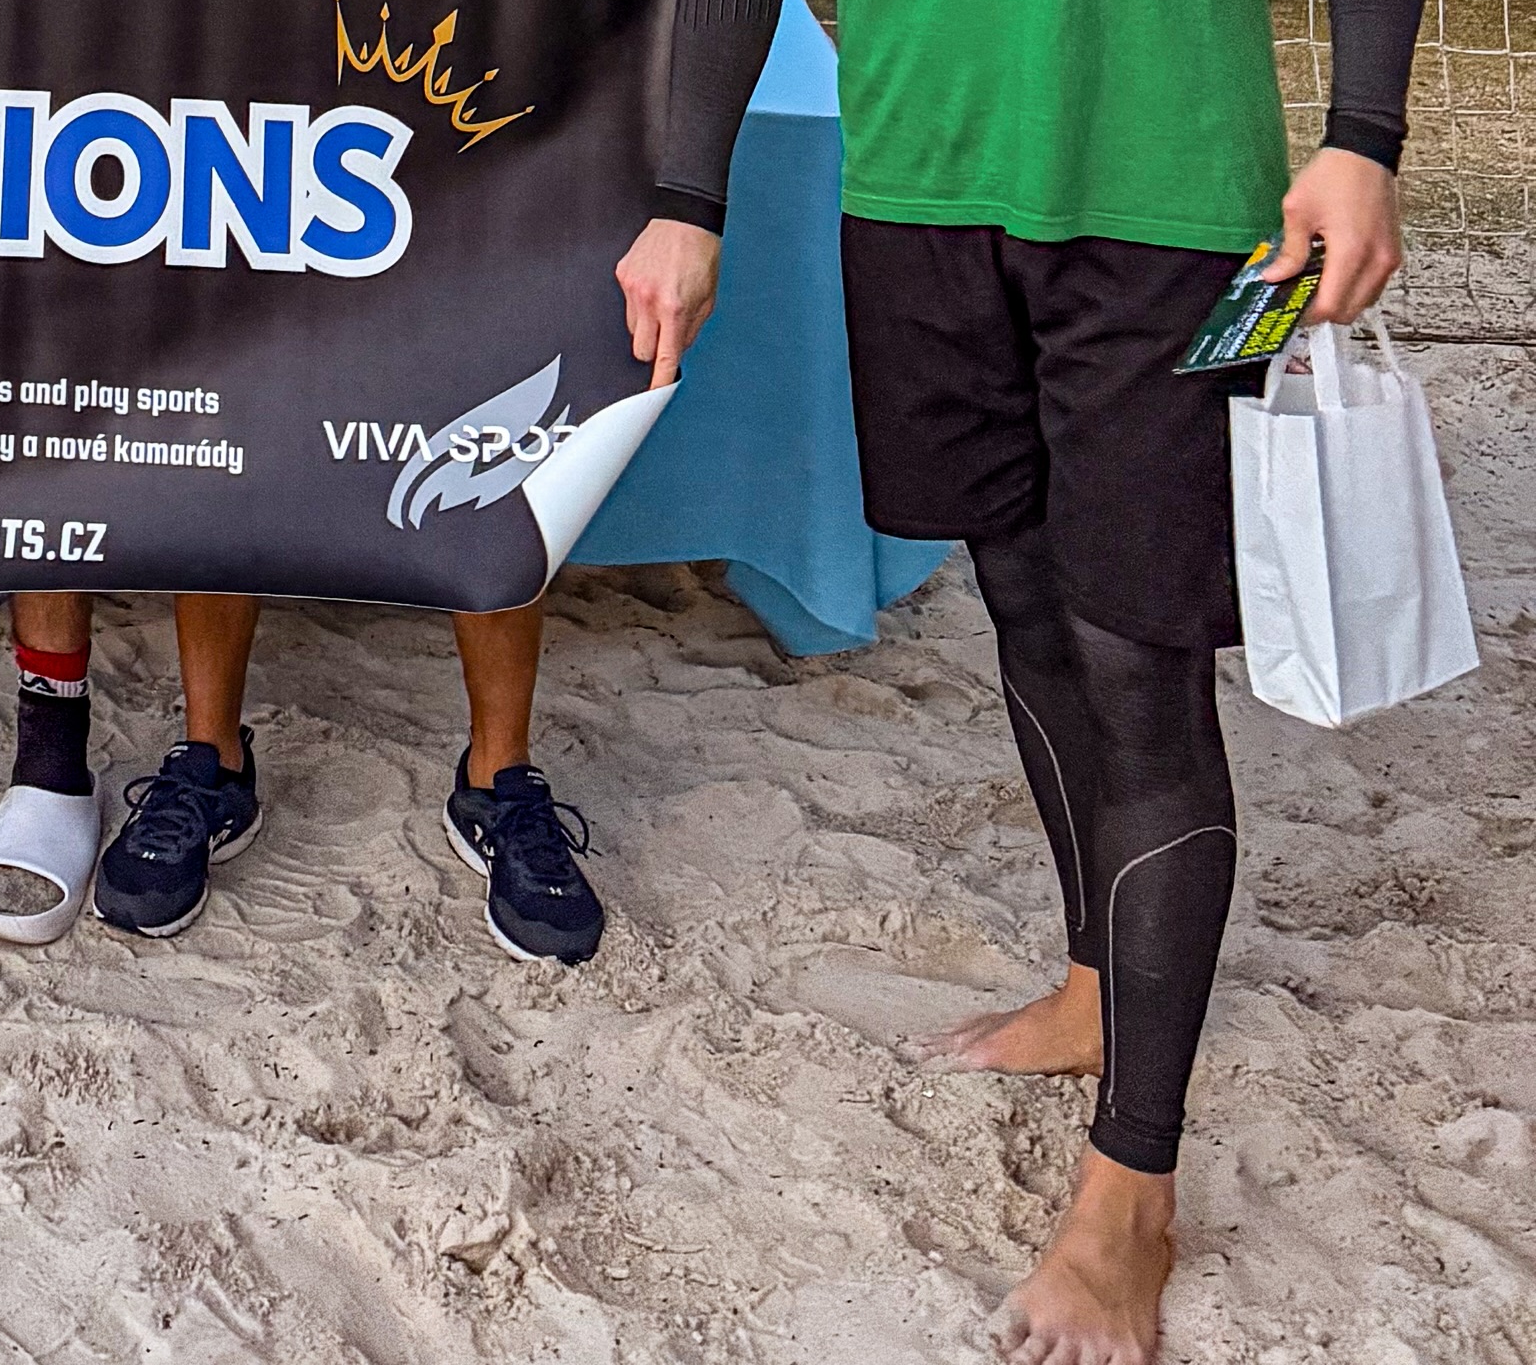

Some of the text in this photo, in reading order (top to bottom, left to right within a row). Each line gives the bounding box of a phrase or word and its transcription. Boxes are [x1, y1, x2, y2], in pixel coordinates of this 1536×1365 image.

[19, 377, 67, 406] and
[74, 379, 129, 415] play
[136, 383, 220, 416] sports
[22, 436, 39, 458] a
[46, 432, 108, 463] nové
[114, 435, 245, 475] kamarády
[322, 421, 433, 463] VIVA
